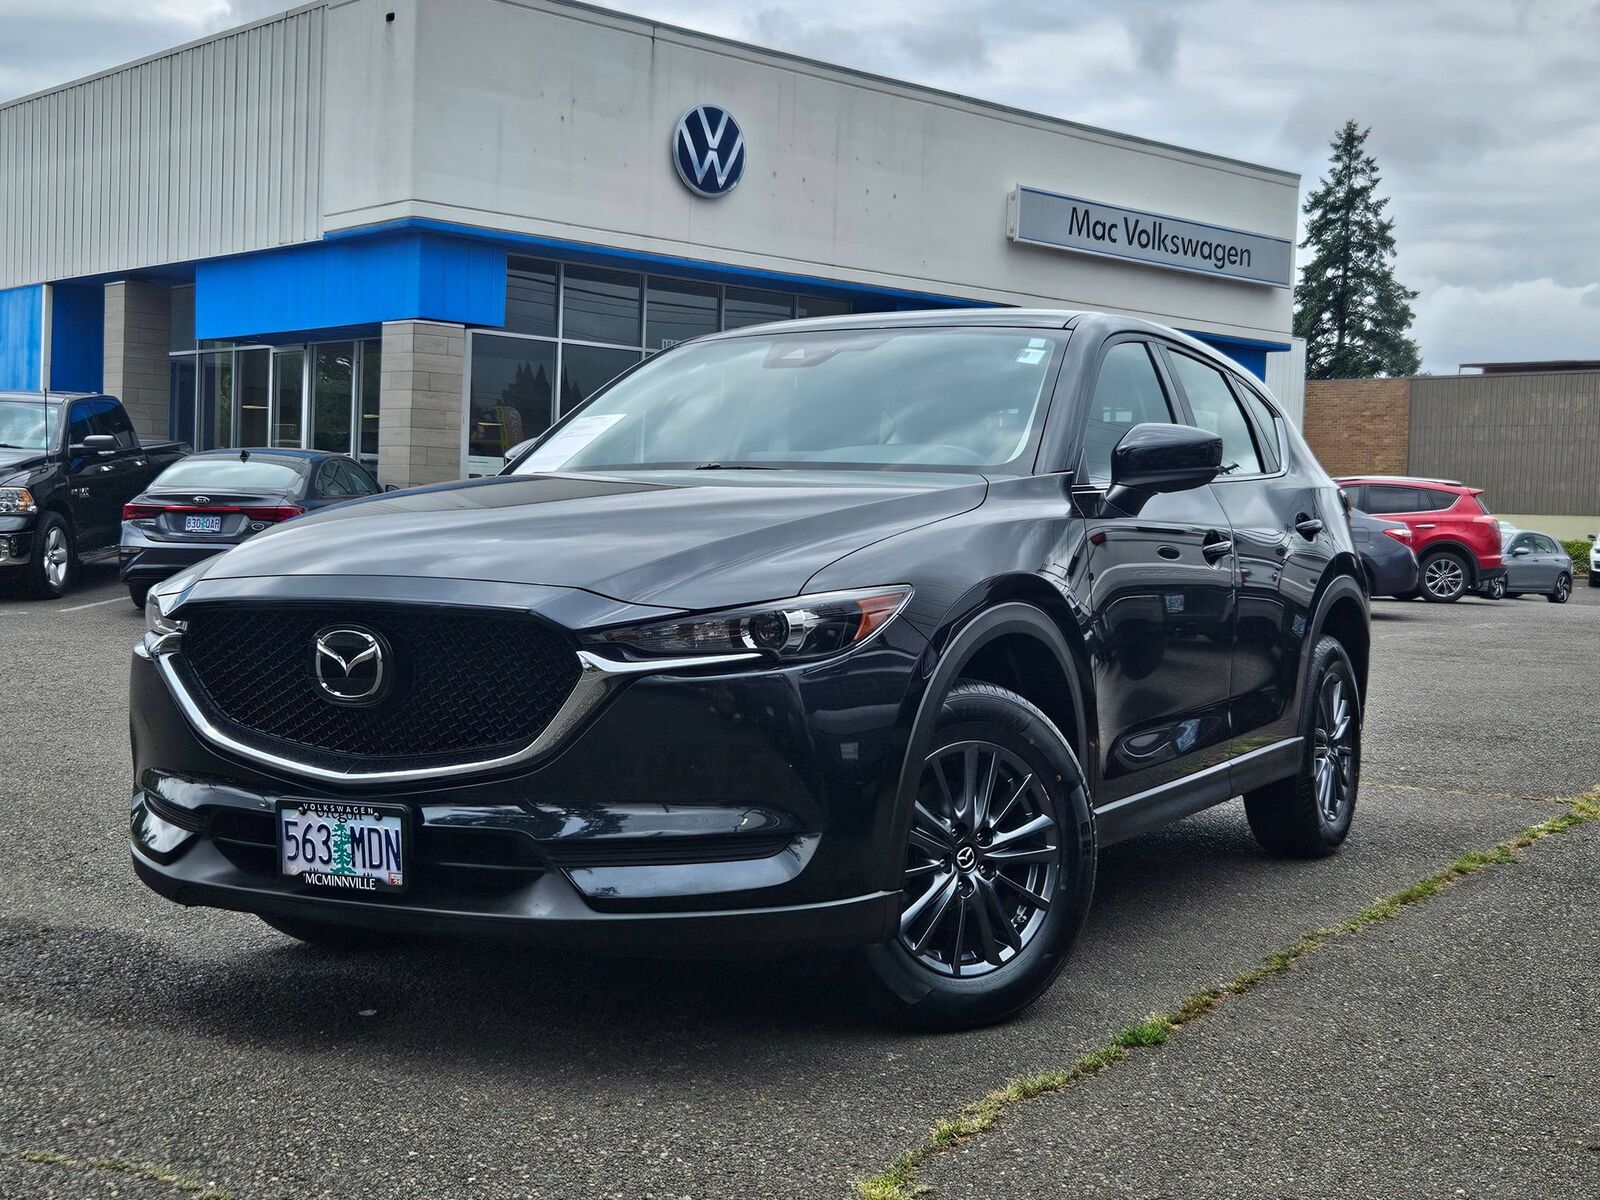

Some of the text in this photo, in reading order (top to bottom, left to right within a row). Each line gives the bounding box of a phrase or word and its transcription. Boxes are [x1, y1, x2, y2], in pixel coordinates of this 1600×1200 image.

[1068, 206, 1251, 270] Mac Volkswagen
[303, 803, 374, 815] VOLKSWAGEN
[284, 820, 401, 871] 563 MDN
[305, 873, 376, 890] MCMINNVILLE
